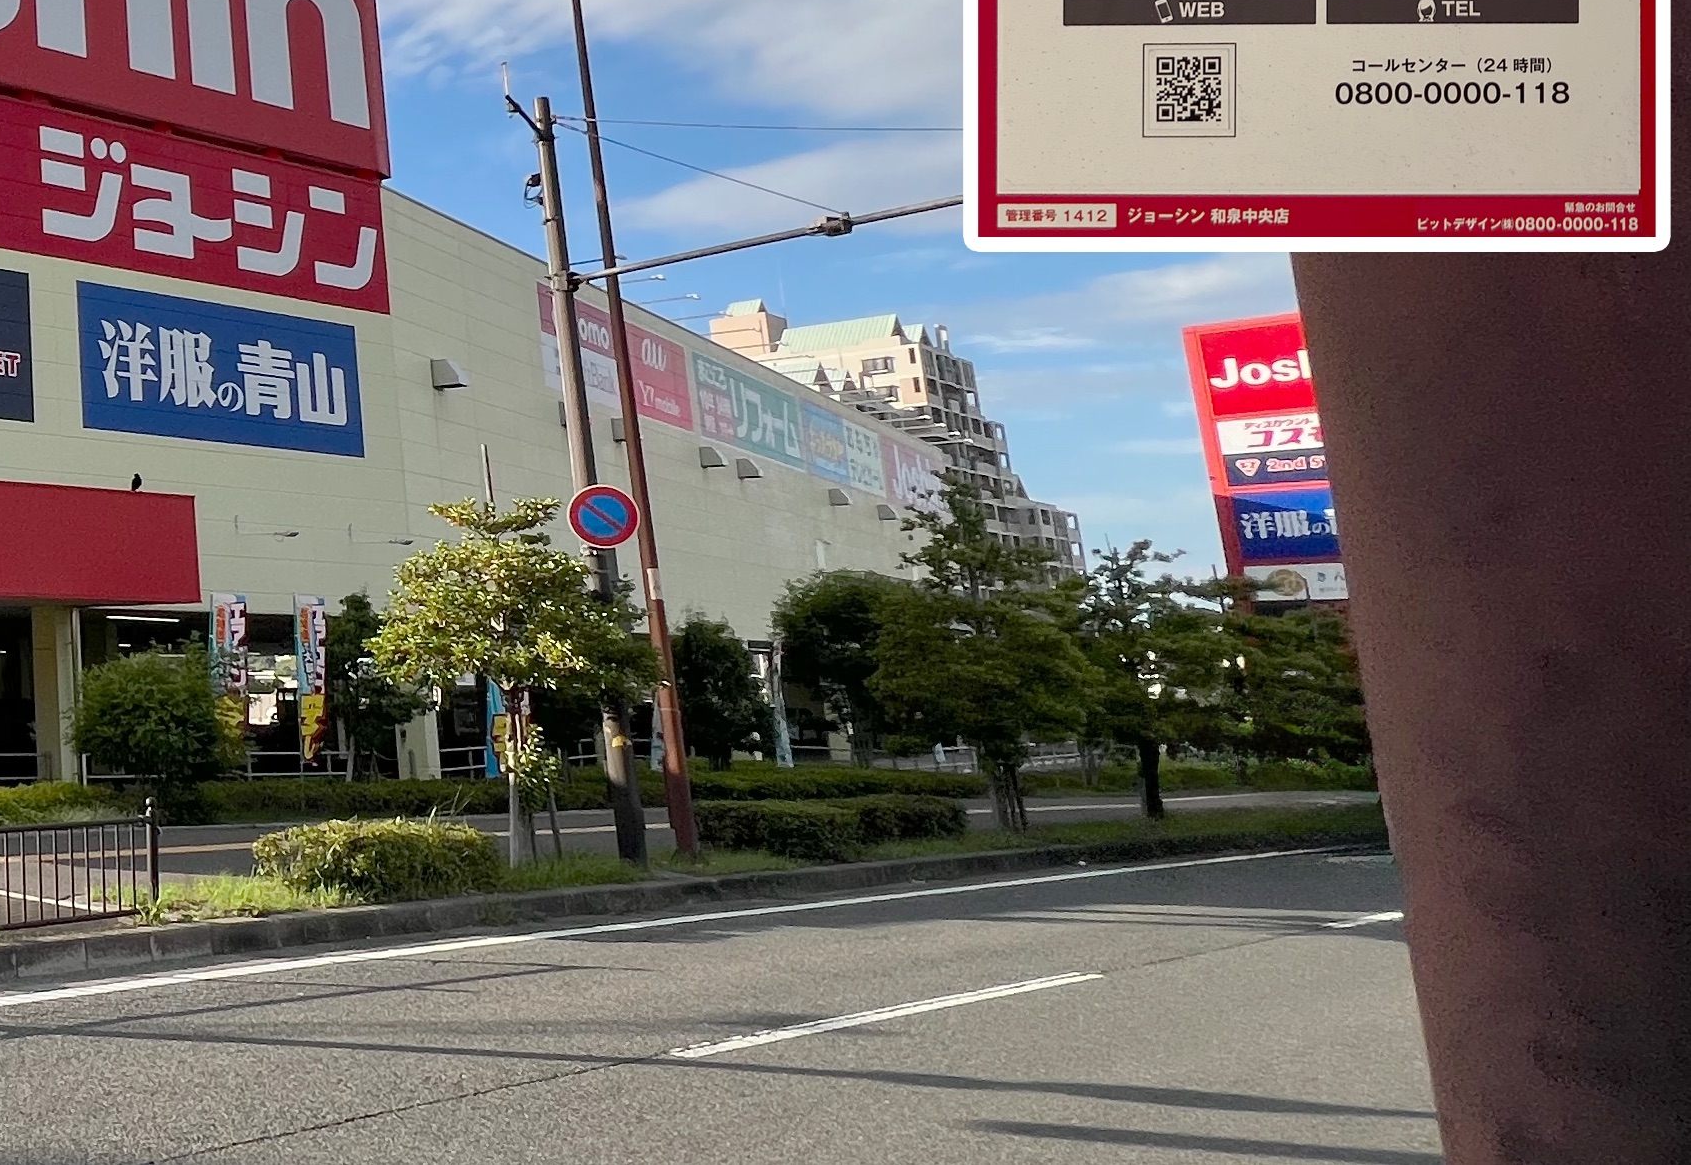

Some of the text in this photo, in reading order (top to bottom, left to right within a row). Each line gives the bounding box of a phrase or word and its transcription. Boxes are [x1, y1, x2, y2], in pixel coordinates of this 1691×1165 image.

[1178, 1, 1226, 18] WEB
[1441, 0, 1481, 17] TEL
[1335, 81, 1570, 105] 0800-0000-118
[38, 125, 378, 291] ジョーシン
[1004, 208, 1108, 224] 管理番号 1412
[1127, 206, 1290, 226] ジョーシン 和泉中央店
[97, 318, 348, 427] 洋服の青山
